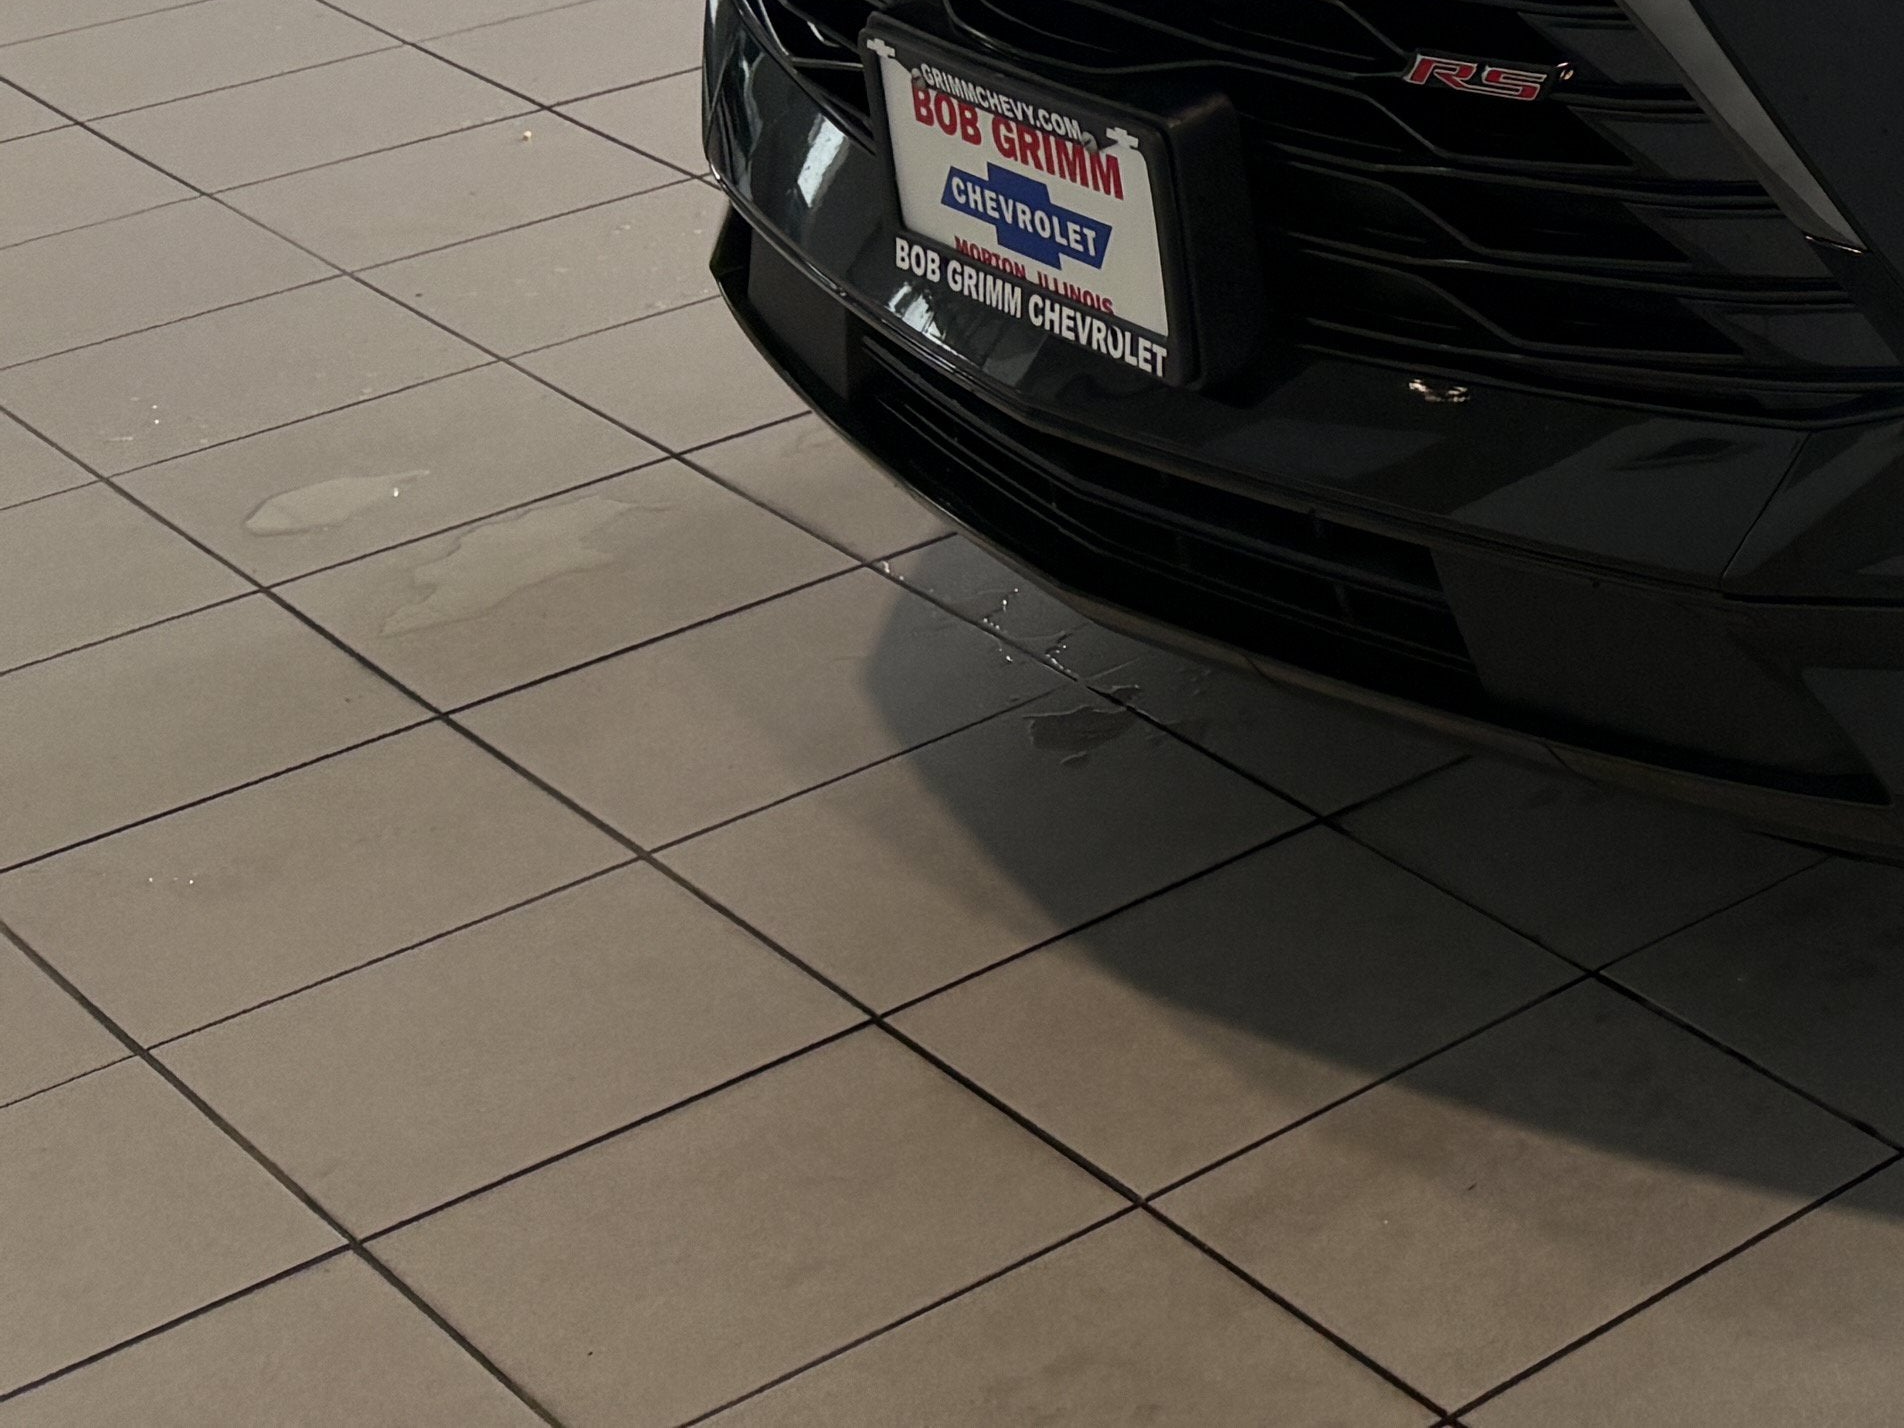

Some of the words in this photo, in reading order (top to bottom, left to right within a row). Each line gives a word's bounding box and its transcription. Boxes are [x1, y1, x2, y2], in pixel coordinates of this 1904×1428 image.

[921, 63, 1081, 139] GRIMMCHEVY.COM
[1403, 54, 1547, 101] RS
[912, 81, 982, 146] BOB
[992, 119, 1124, 200] GRIMM
[951, 176, 1097, 257] CHEVROLET
[954, 235, 1026, 279] MORTON
[895, 238, 940, 284] BOB
[947, 260, 1022, 319] GRIMM
[1028, 295, 1168, 377] CHEVROLET
